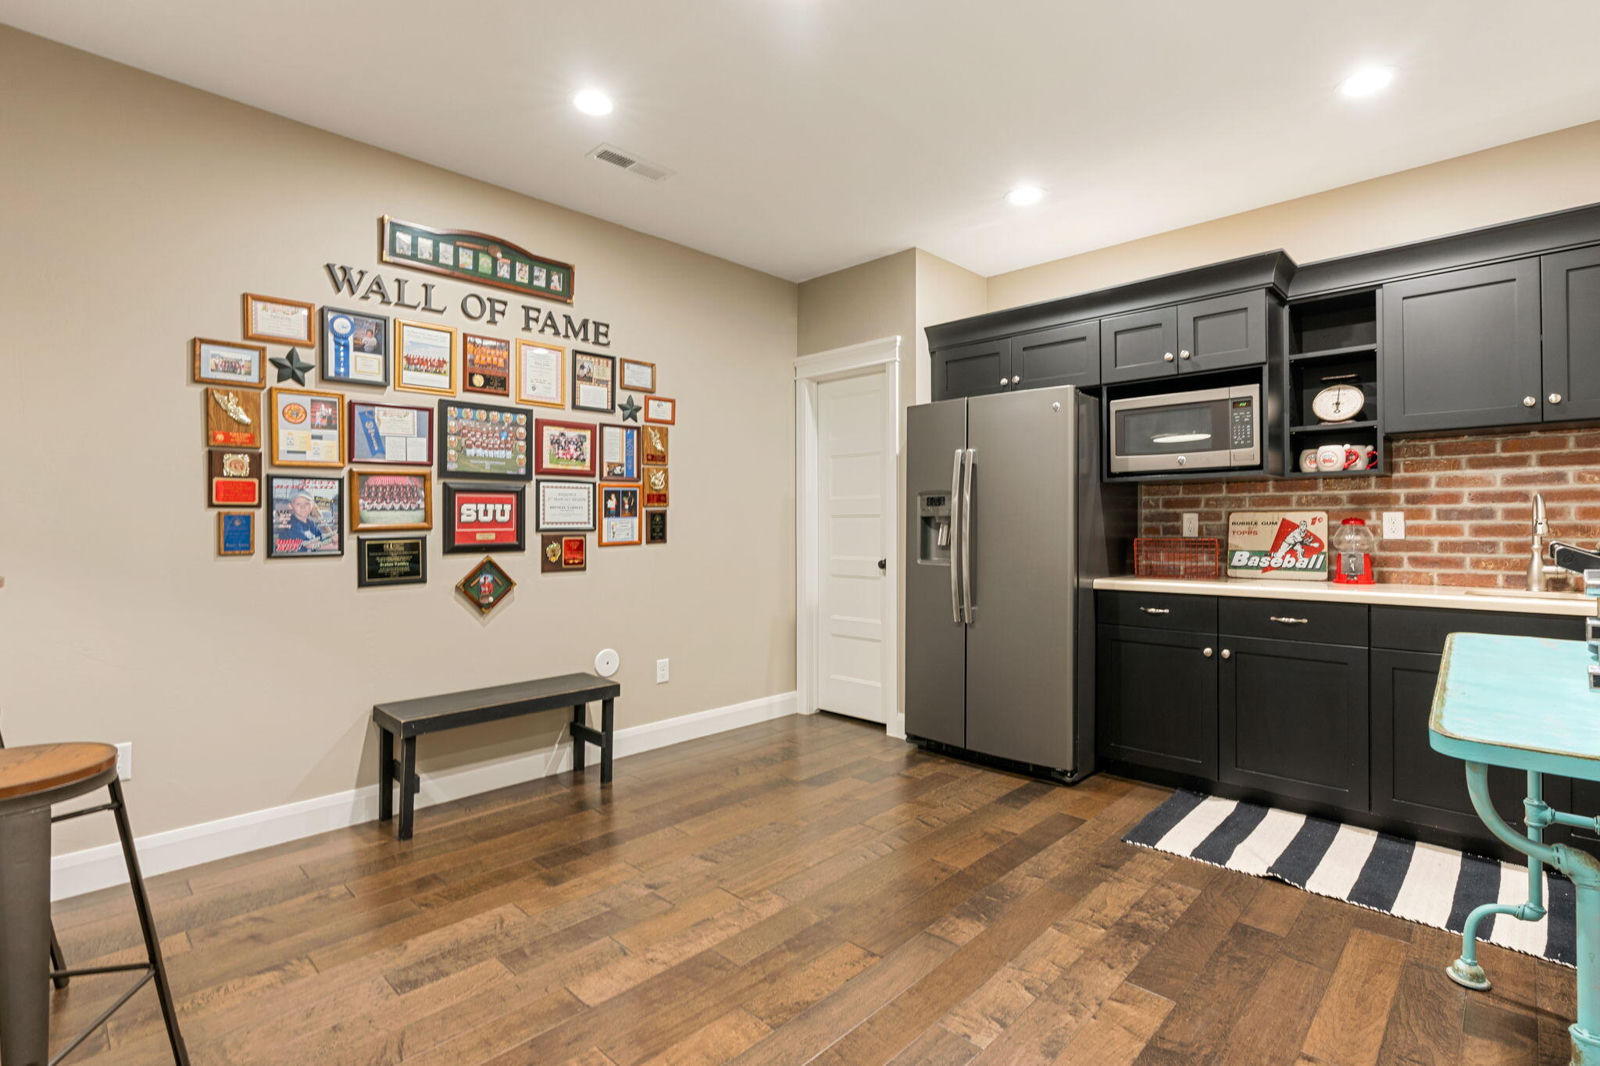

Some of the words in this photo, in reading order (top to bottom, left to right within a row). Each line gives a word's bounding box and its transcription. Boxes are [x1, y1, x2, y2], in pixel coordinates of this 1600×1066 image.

[326, 263, 447, 313] WALL
[461, 293, 508, 324] OF
[521, 304, 611, 346] FAME
[460, 503, 512, 523] SUU
[1231, 551, 1325, 569] Baseball
